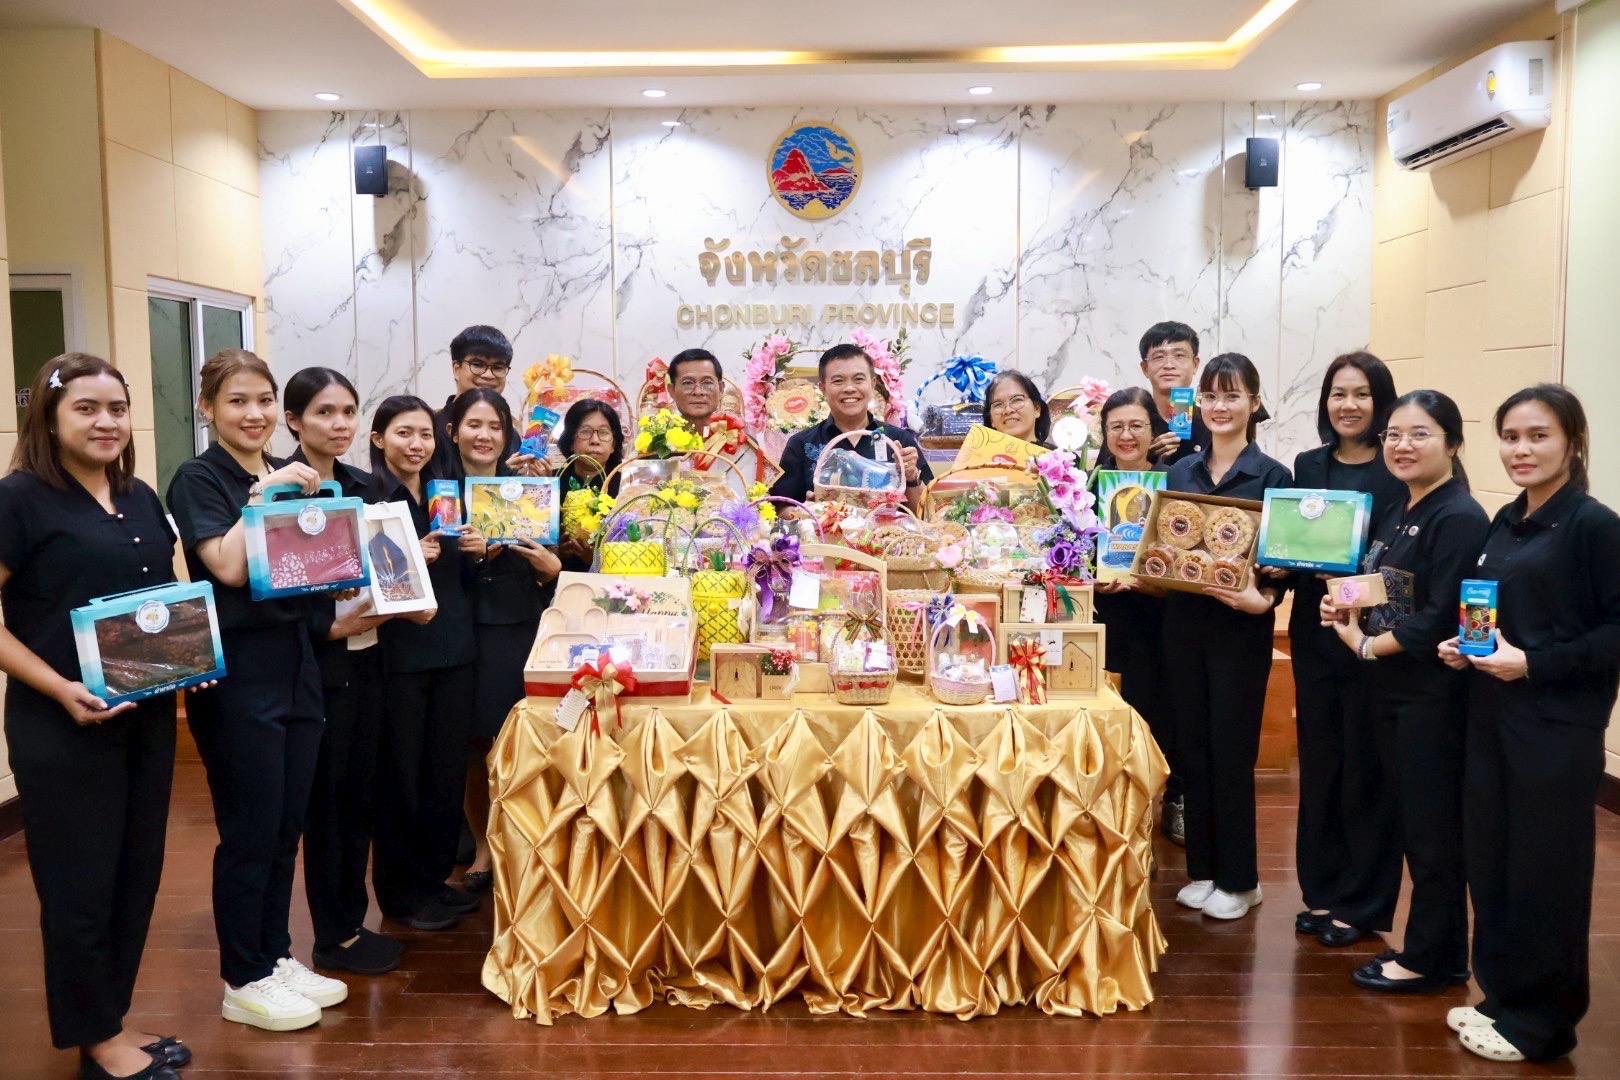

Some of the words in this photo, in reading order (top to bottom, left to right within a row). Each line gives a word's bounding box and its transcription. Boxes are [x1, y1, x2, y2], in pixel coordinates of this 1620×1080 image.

[698, 236, 932, 295] จังหวัดชลบุรี
[677, 302, 812, 325] CHONBURI
[825, 302, 955, 325] PROVINCE
